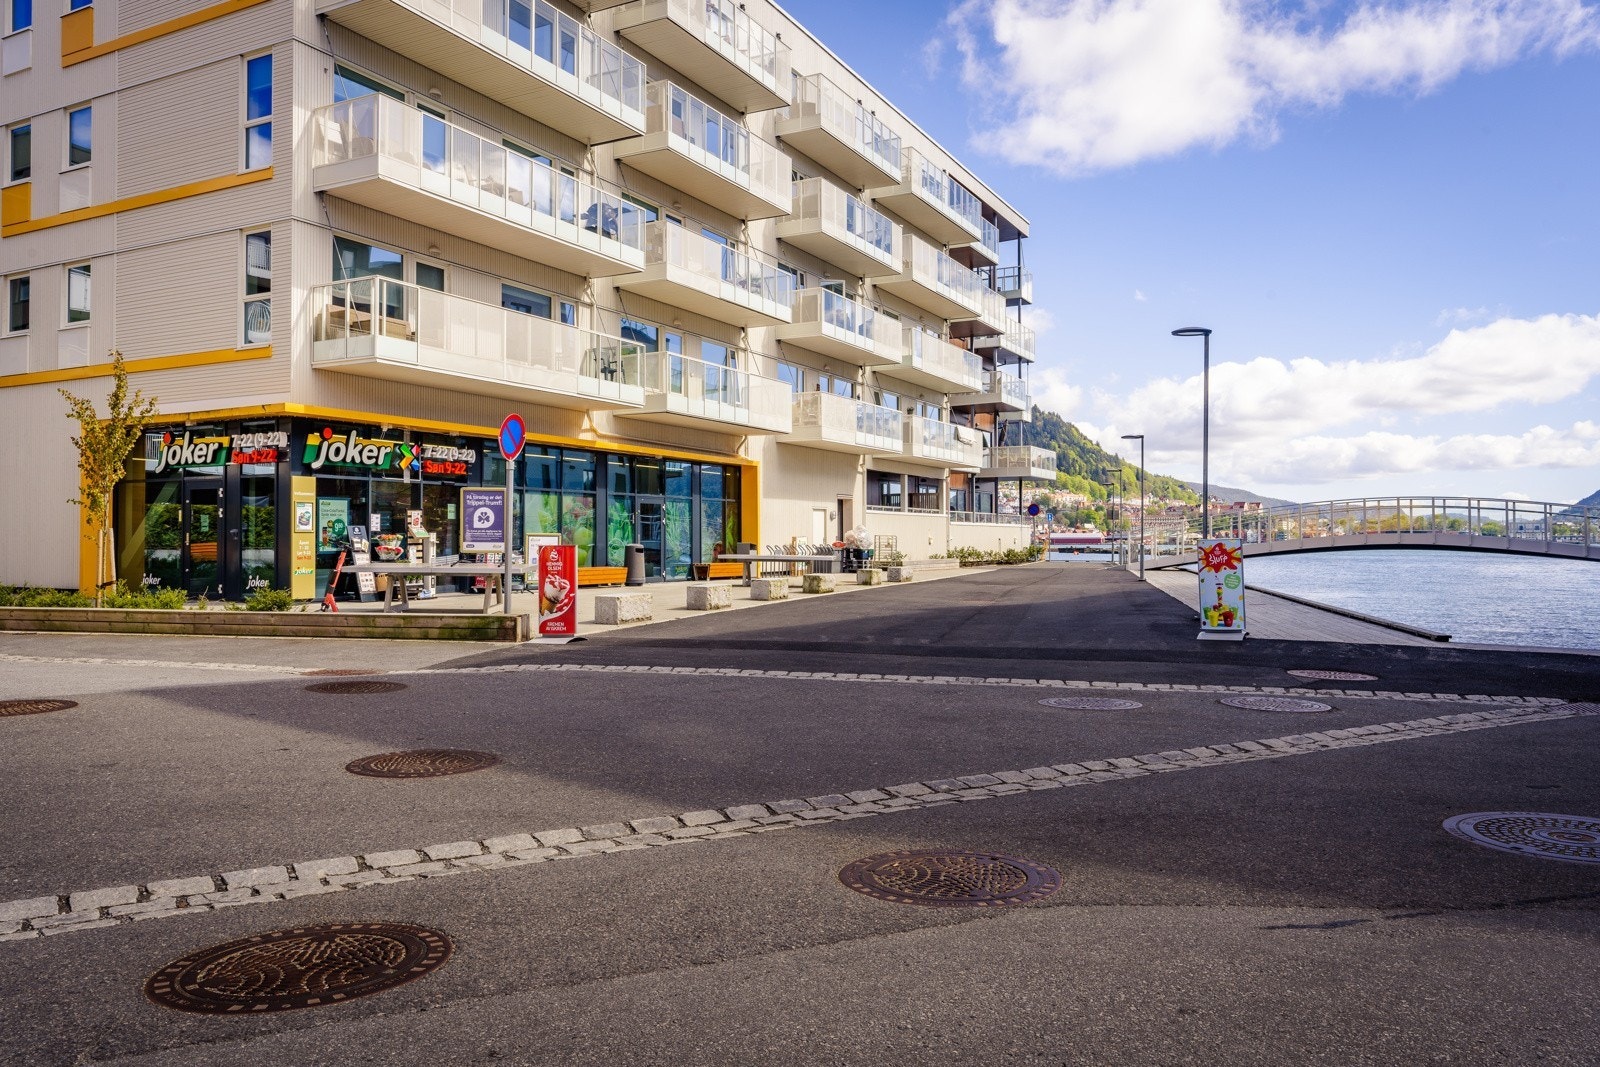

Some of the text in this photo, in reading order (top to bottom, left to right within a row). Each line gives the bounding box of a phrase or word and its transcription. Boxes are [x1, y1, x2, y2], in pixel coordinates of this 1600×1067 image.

[156, 431, 219, 473] joker
[311, 428, 391, 469] joker
[232, 450, 249, 463] Søn
[427, 460, 466, 475] Søn 9-22
[141, 573, 161, 586] joker
[246, 575, 269, 589] joker
